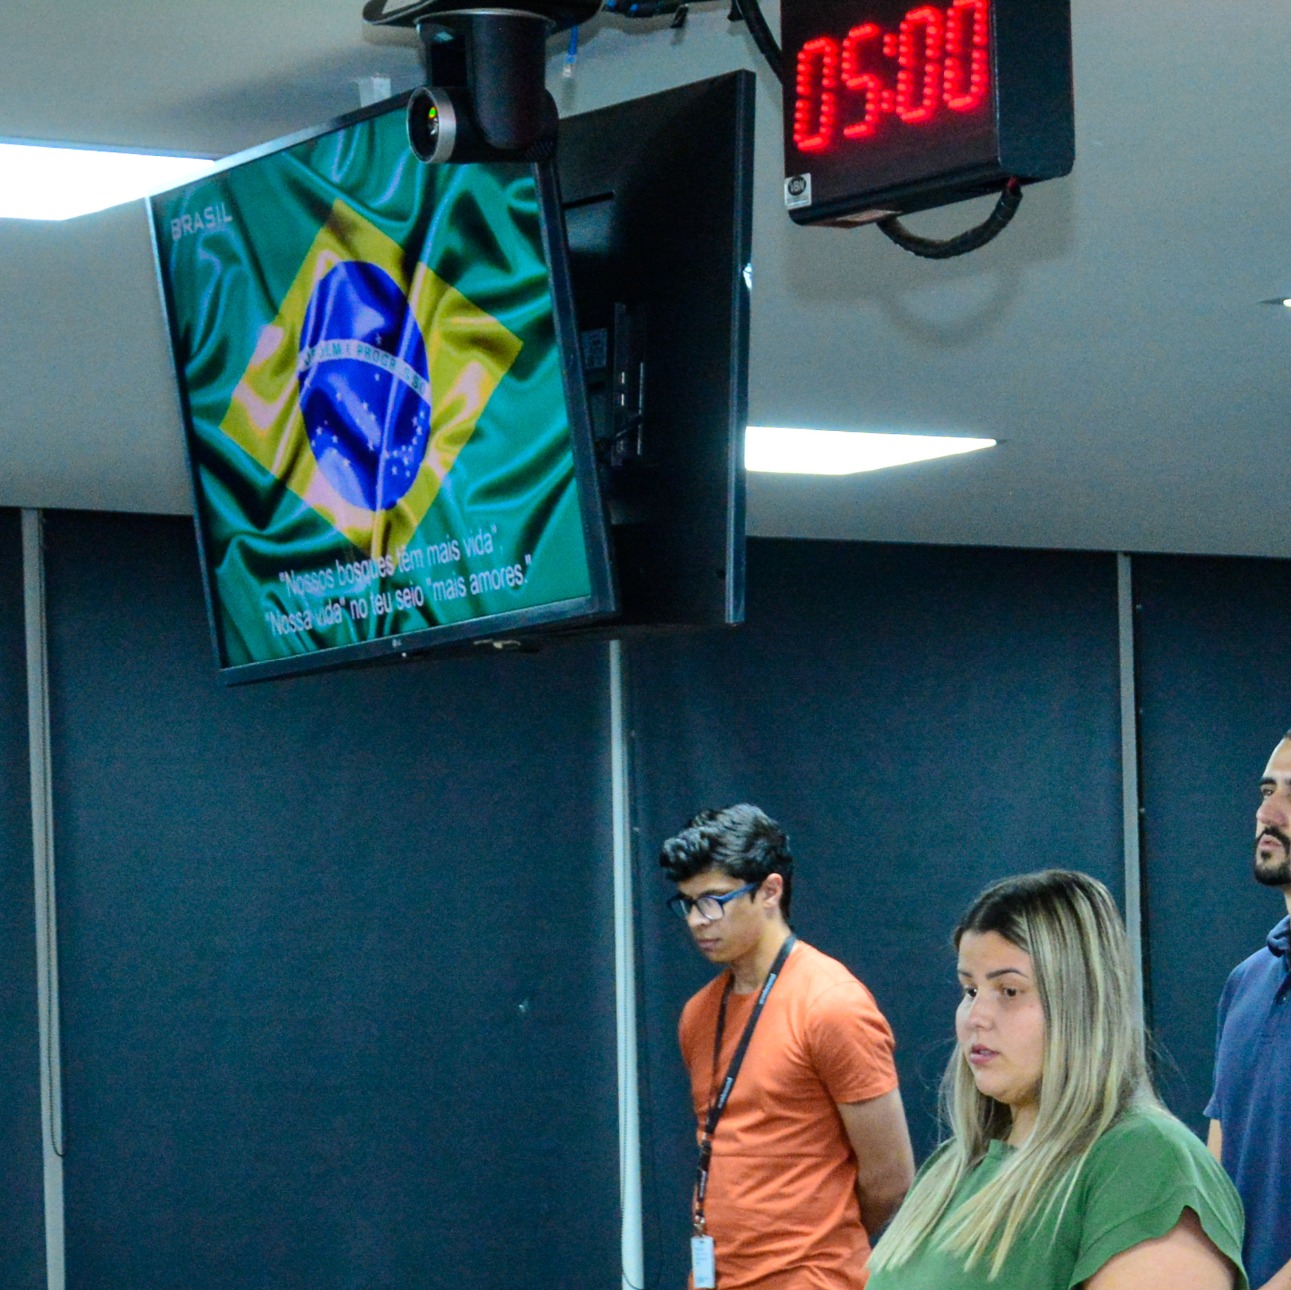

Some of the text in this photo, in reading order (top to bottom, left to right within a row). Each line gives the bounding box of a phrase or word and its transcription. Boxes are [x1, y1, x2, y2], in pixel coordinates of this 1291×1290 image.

[793, 0, 989, 151] 05:00
[171, 201, 232, 240] BRASIL
[336, 554, 395, 589] bosques
[427, 533, 461, 565] mais
[349, 598, 368, 620] no
[370, 591, 393, 616] teu
[395, 579, 425, 611] seio
